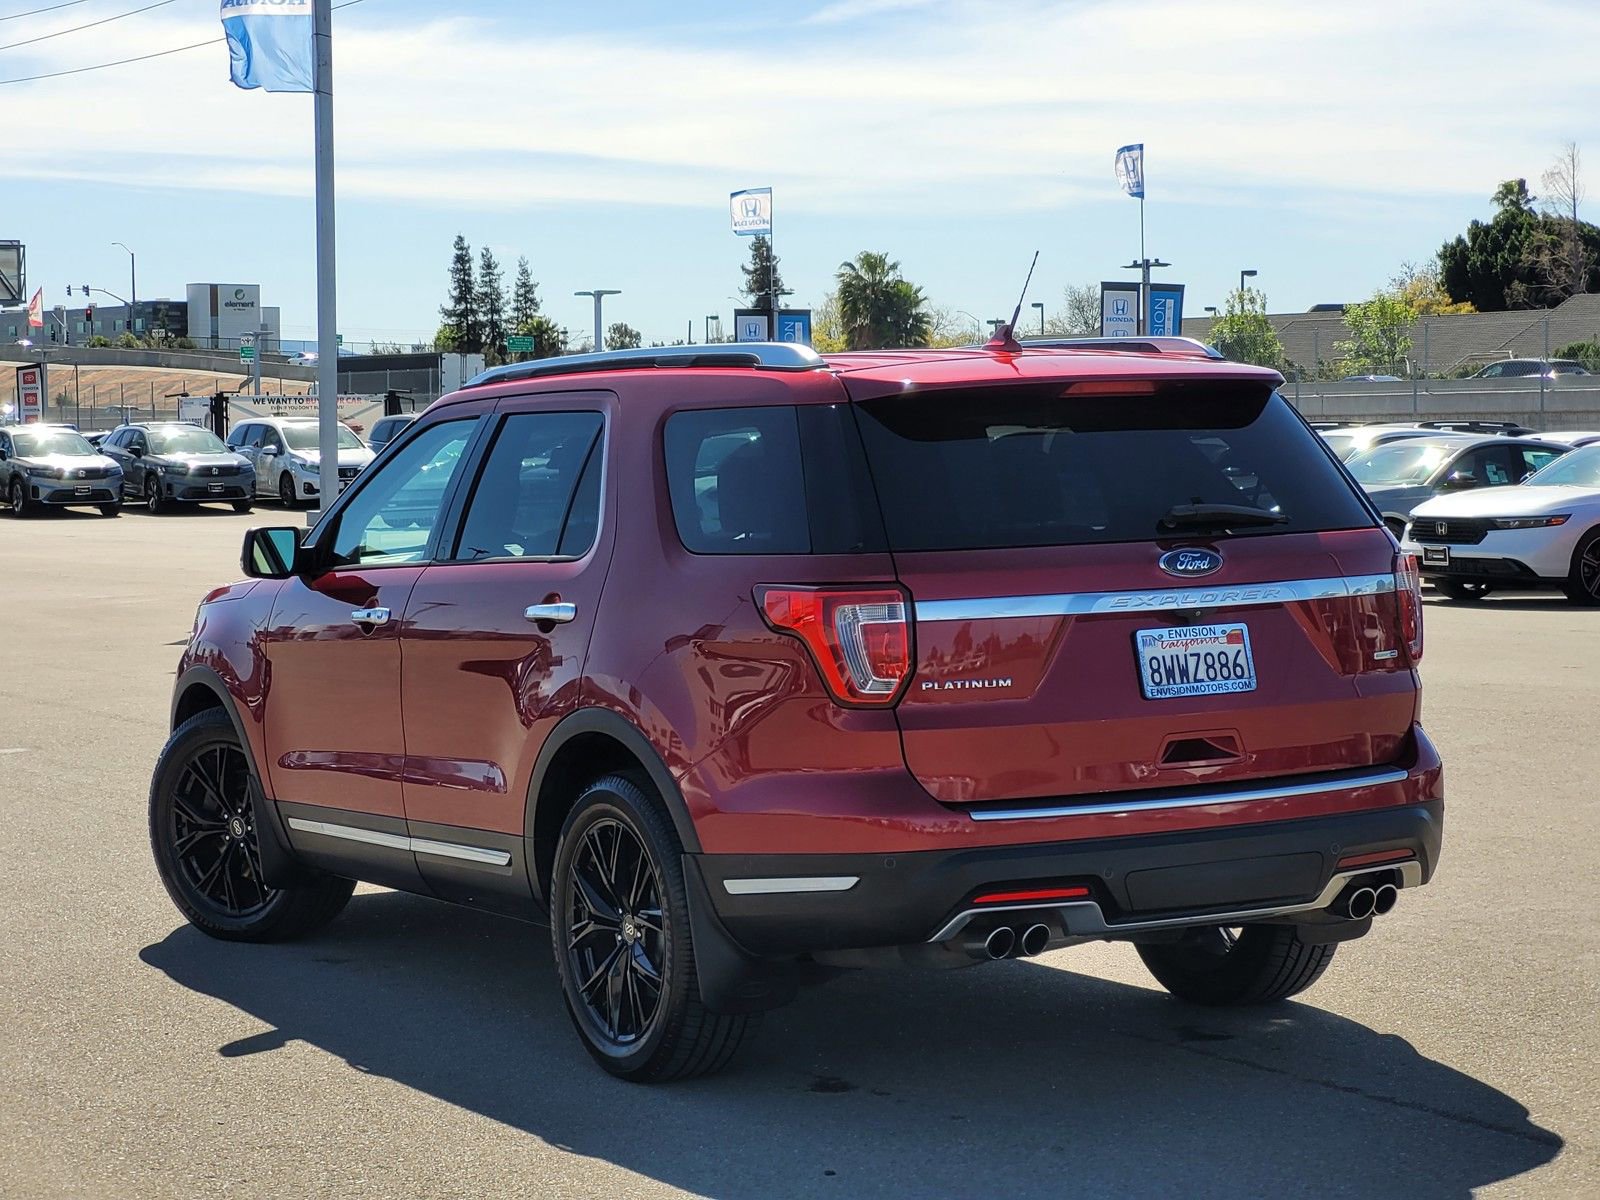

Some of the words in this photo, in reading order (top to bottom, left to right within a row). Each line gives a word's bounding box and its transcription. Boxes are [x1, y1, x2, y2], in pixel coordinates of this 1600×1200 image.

[252, 397, 266, 405] WE
[267, 397, 292, 405] WANT
[293, 397, 304, 405] TO
[1177, 552, 1211, 570] Ford
[1110, 587, 1281, 608] EXPLORER
[1168, 627, 1216, 639] ENVISION
[1148, 649, 1245, 686] 8WWZ886
[921, 678, 1012, 690] PLATINUM
[1150, 680, 1253, 697] ENVISIONMOTORS.COM
